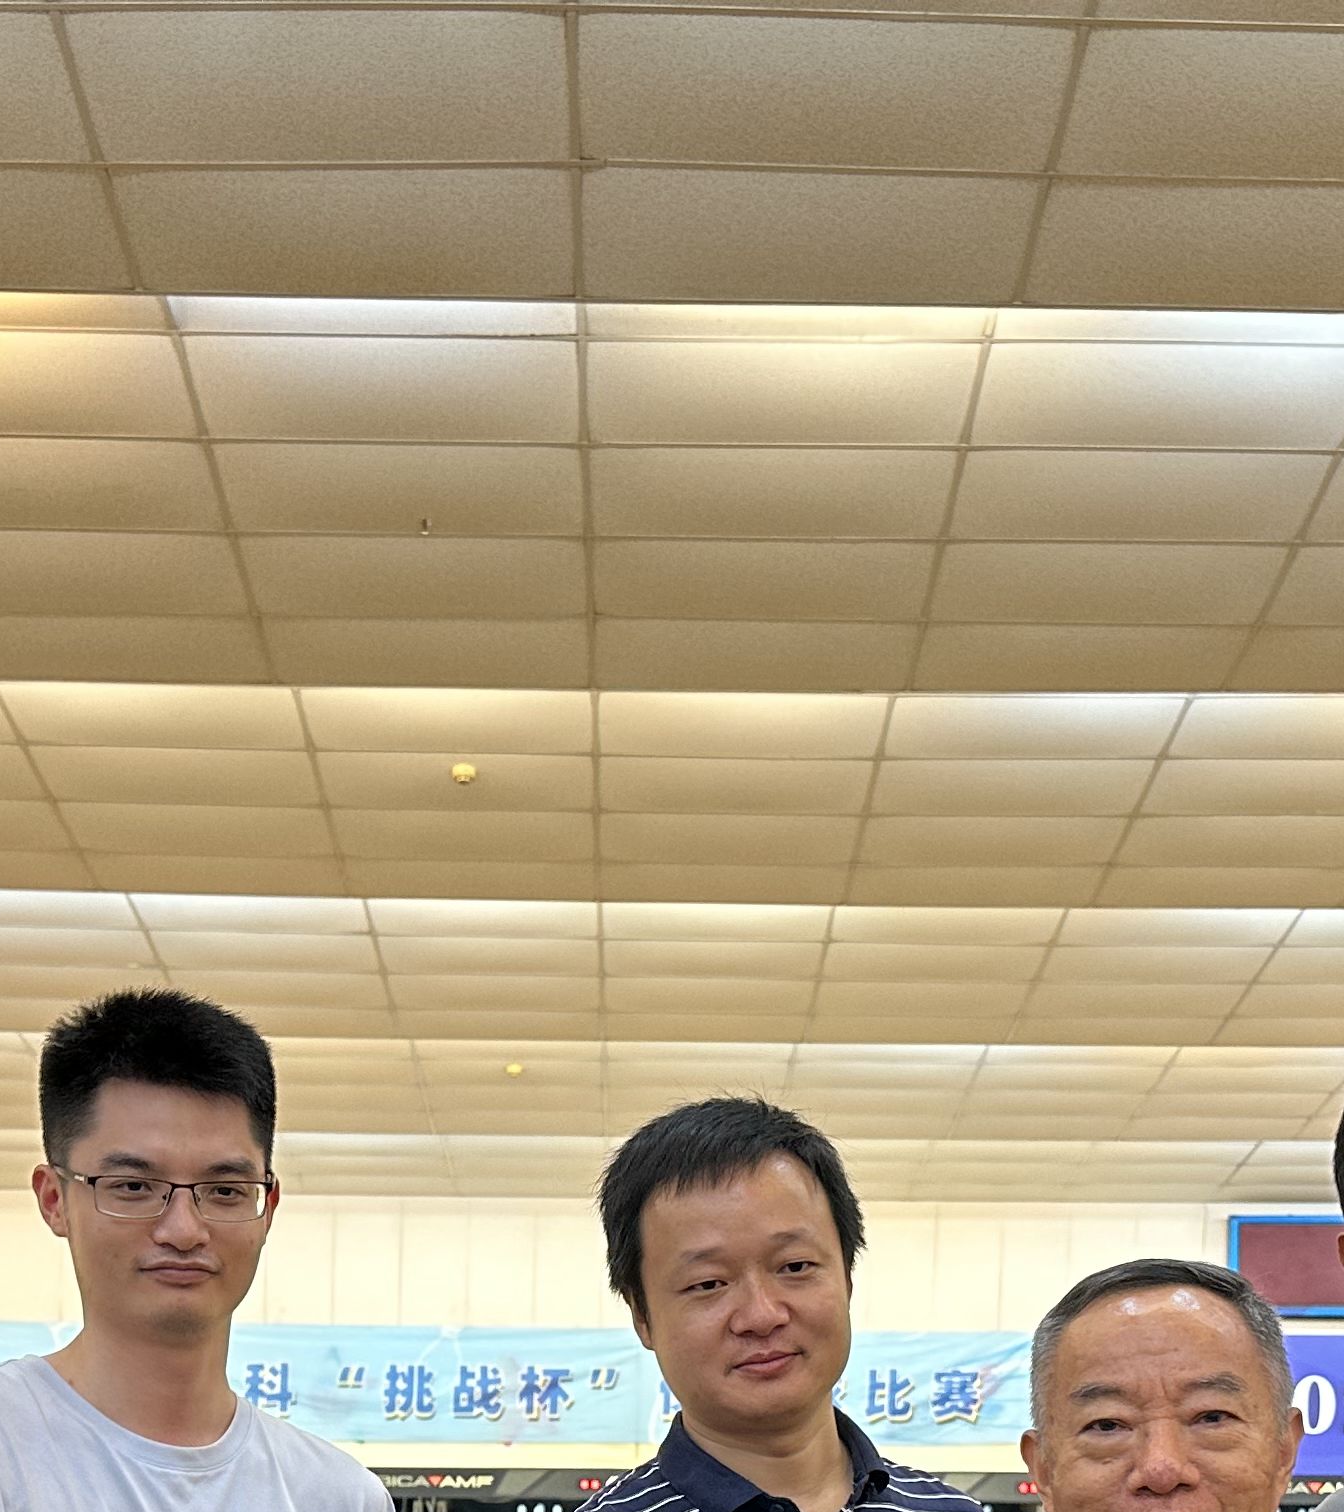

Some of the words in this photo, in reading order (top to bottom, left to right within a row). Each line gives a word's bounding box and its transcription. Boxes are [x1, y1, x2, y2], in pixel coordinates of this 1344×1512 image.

[245, 1362, 682, 1421] 科“挑战杯”
[833, 1369, 984, 1424] 比赛
